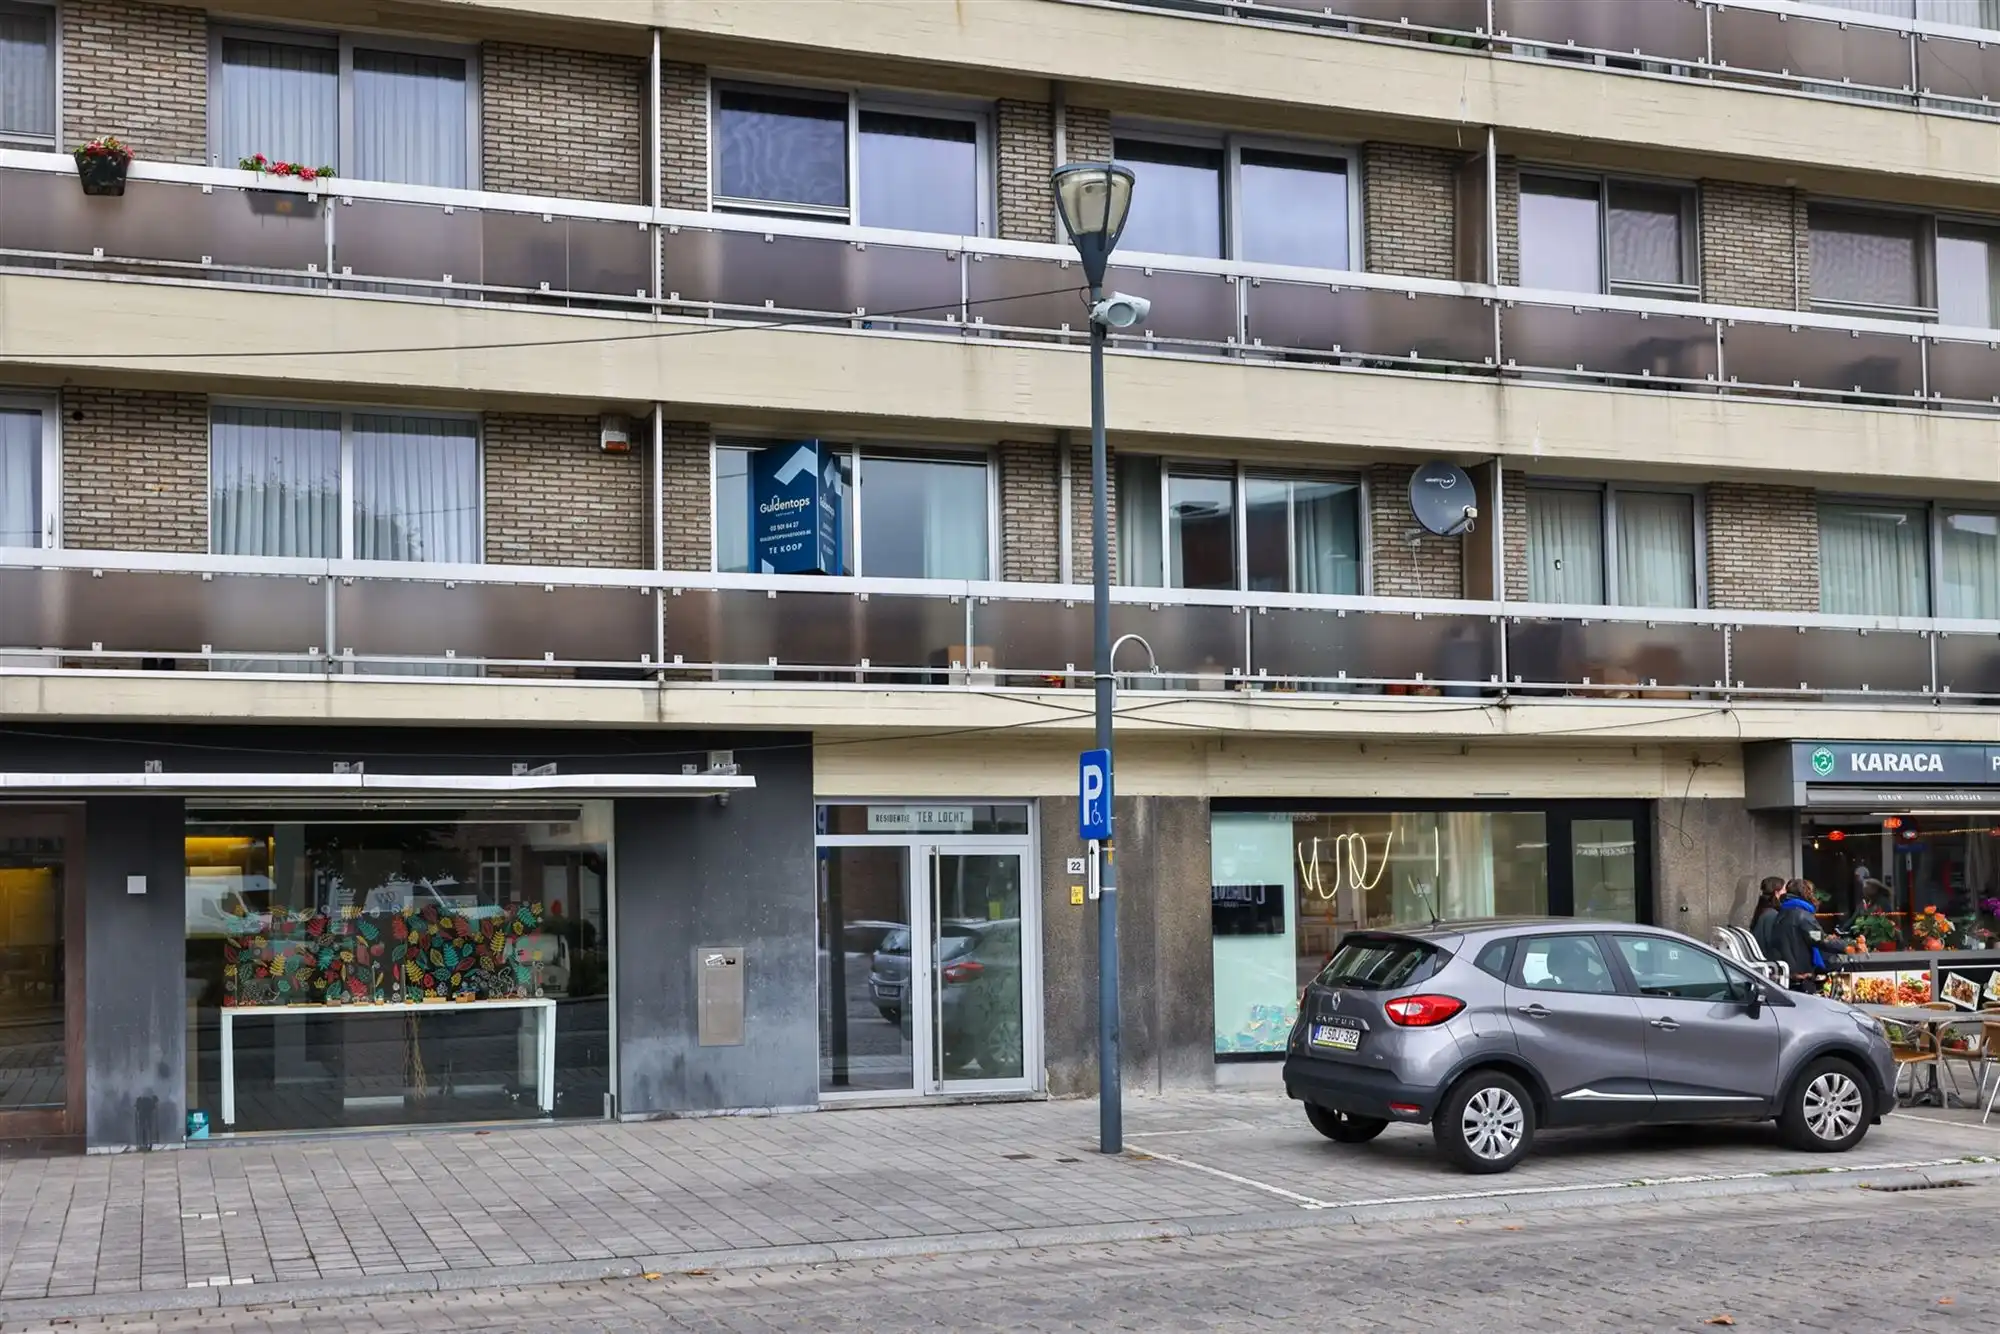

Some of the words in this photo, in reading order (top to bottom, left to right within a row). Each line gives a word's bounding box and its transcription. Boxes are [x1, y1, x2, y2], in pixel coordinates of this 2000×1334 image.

[760, 495, 810, 513] Guldentops
[769, 546, 778, 555] TE
[780, 543, 802, 552] KOOP
[1851, 753, 1944, 772] KARACA
[1083, 764, 1103, 826] P
[875, 814, 910, 823] RESIDENTIE
[918, 811, 933, 823] TER
[1071, 861, 1081, 871] 22
[1315, 1015, 1355, 1027] CAPTUR
